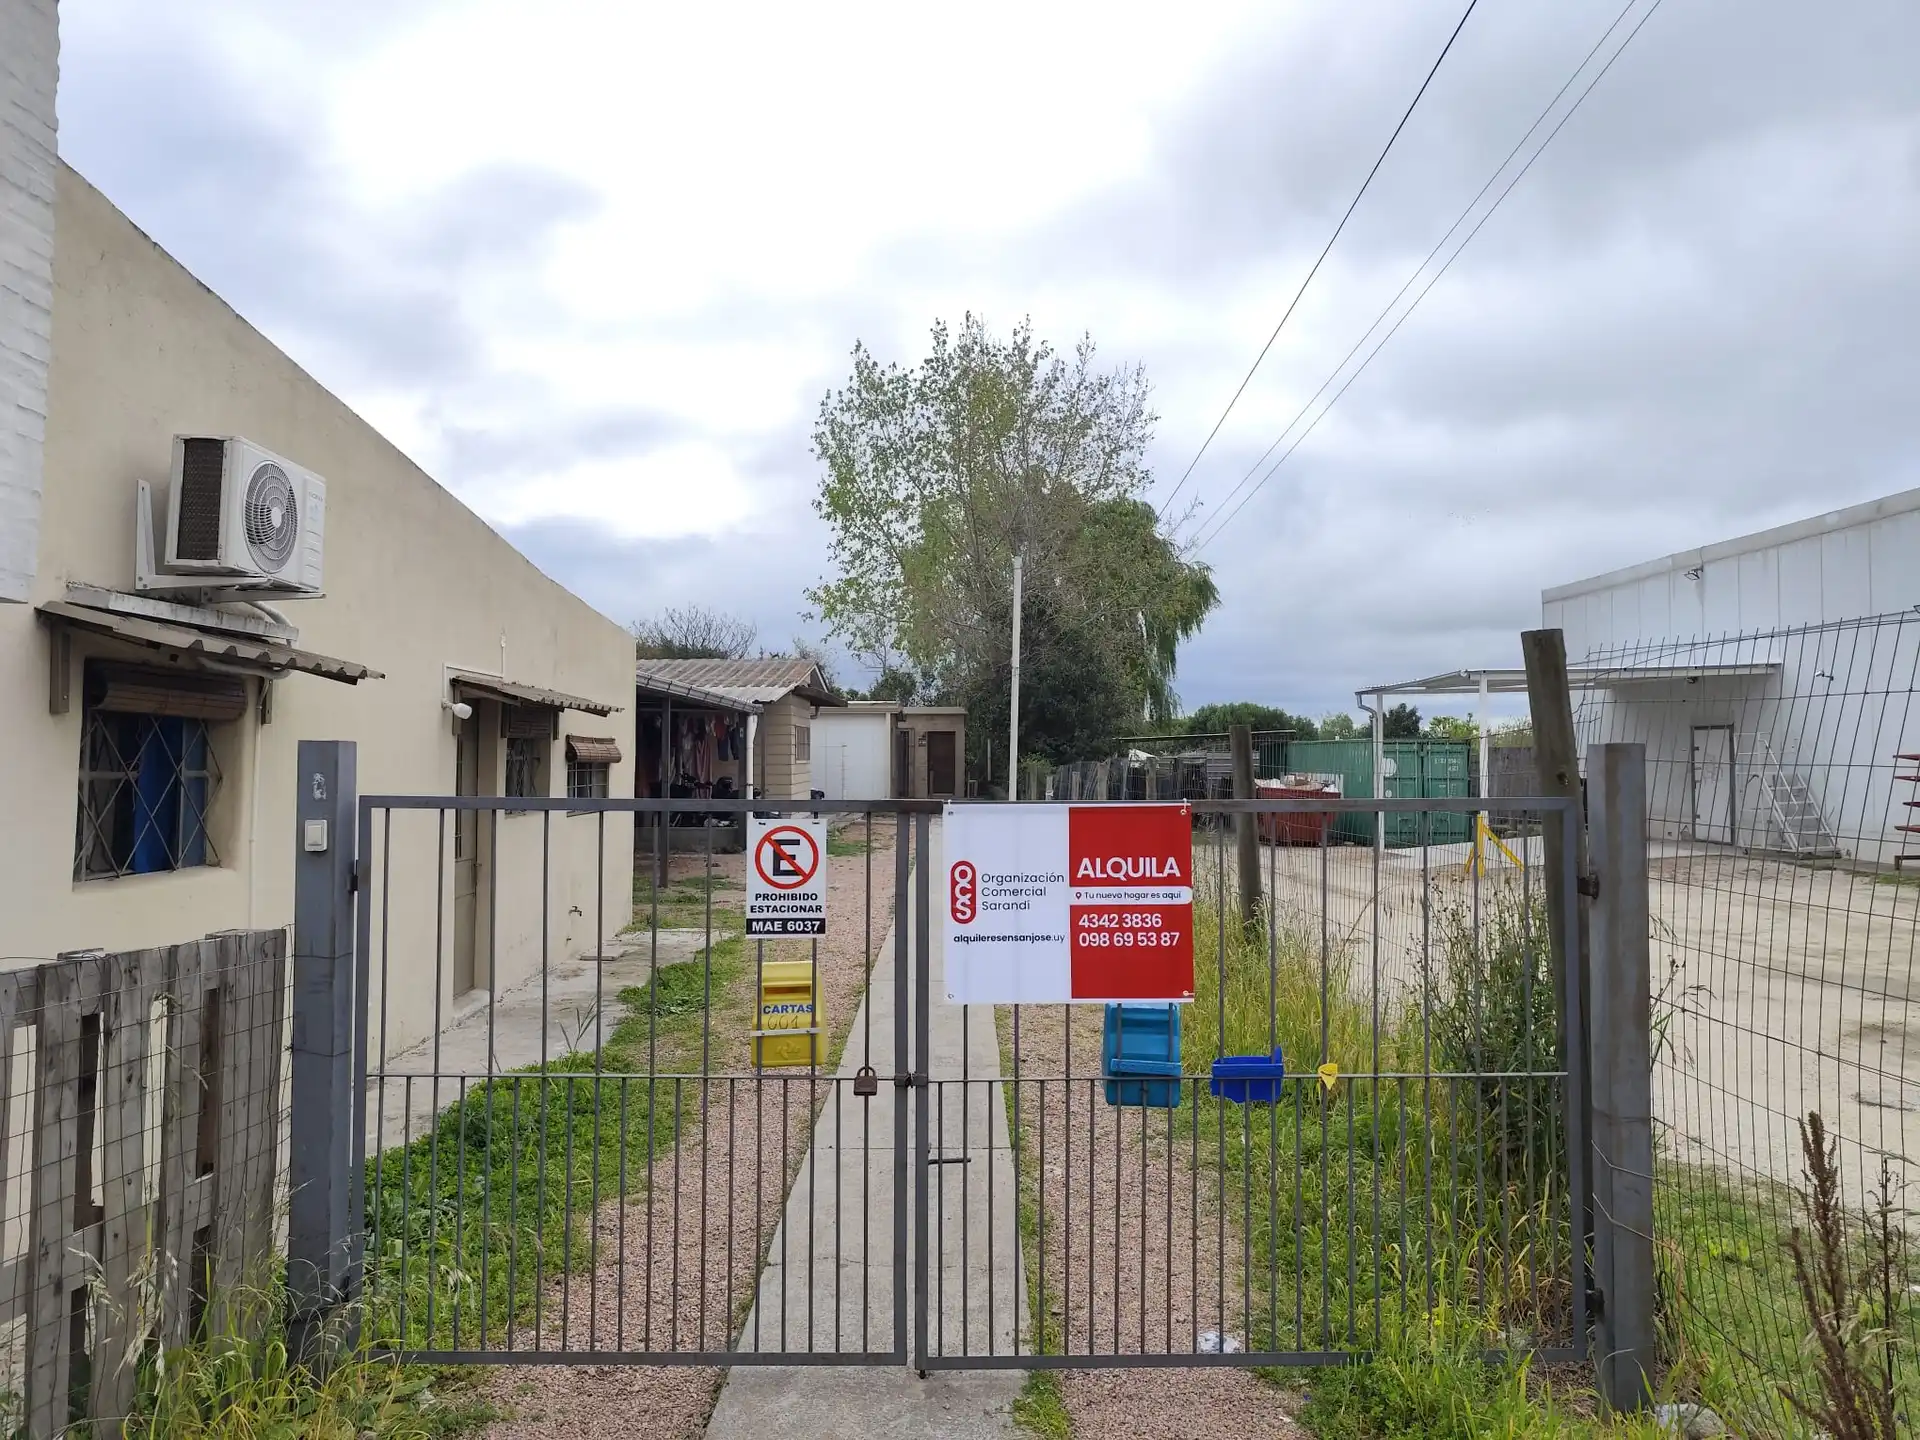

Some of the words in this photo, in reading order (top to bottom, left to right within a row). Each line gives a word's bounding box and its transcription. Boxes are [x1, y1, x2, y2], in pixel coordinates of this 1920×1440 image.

[1076, 856, 1181, 881] ALQUILA
[981, 872, 1065, 886] Organización
[954, 865, 973, 920] OCS
[981, 886, 1047, 897] Comercial
[1084, 891, 1094, 899] Tu
[1124, 891, 1149, 901] hogar
[1162, 890, 1182, 901] aquí
[755, 893, 818, 902] PROHIBIDO
[750, 905, 823, 913] ESTACIONAR
[981, 900, 1031, 911] Sarandí
[1078, 913, 1120, 928] 4342
[1122, 913, 1162, 928] 3836
[751, 921, 783, 932] MAE
[786, 921, 821, 932] 6037
[953, 932, 1066, 945] alquileresensanjose.uy
[1079, 932, 1110, 947] 098
[1113, 932, 1134, 947] 69
[1137, 932, 1157, 947] 53
[1160, 932, 1180, 946] 87
[763, 1004, 814, 1014] CARTAS
